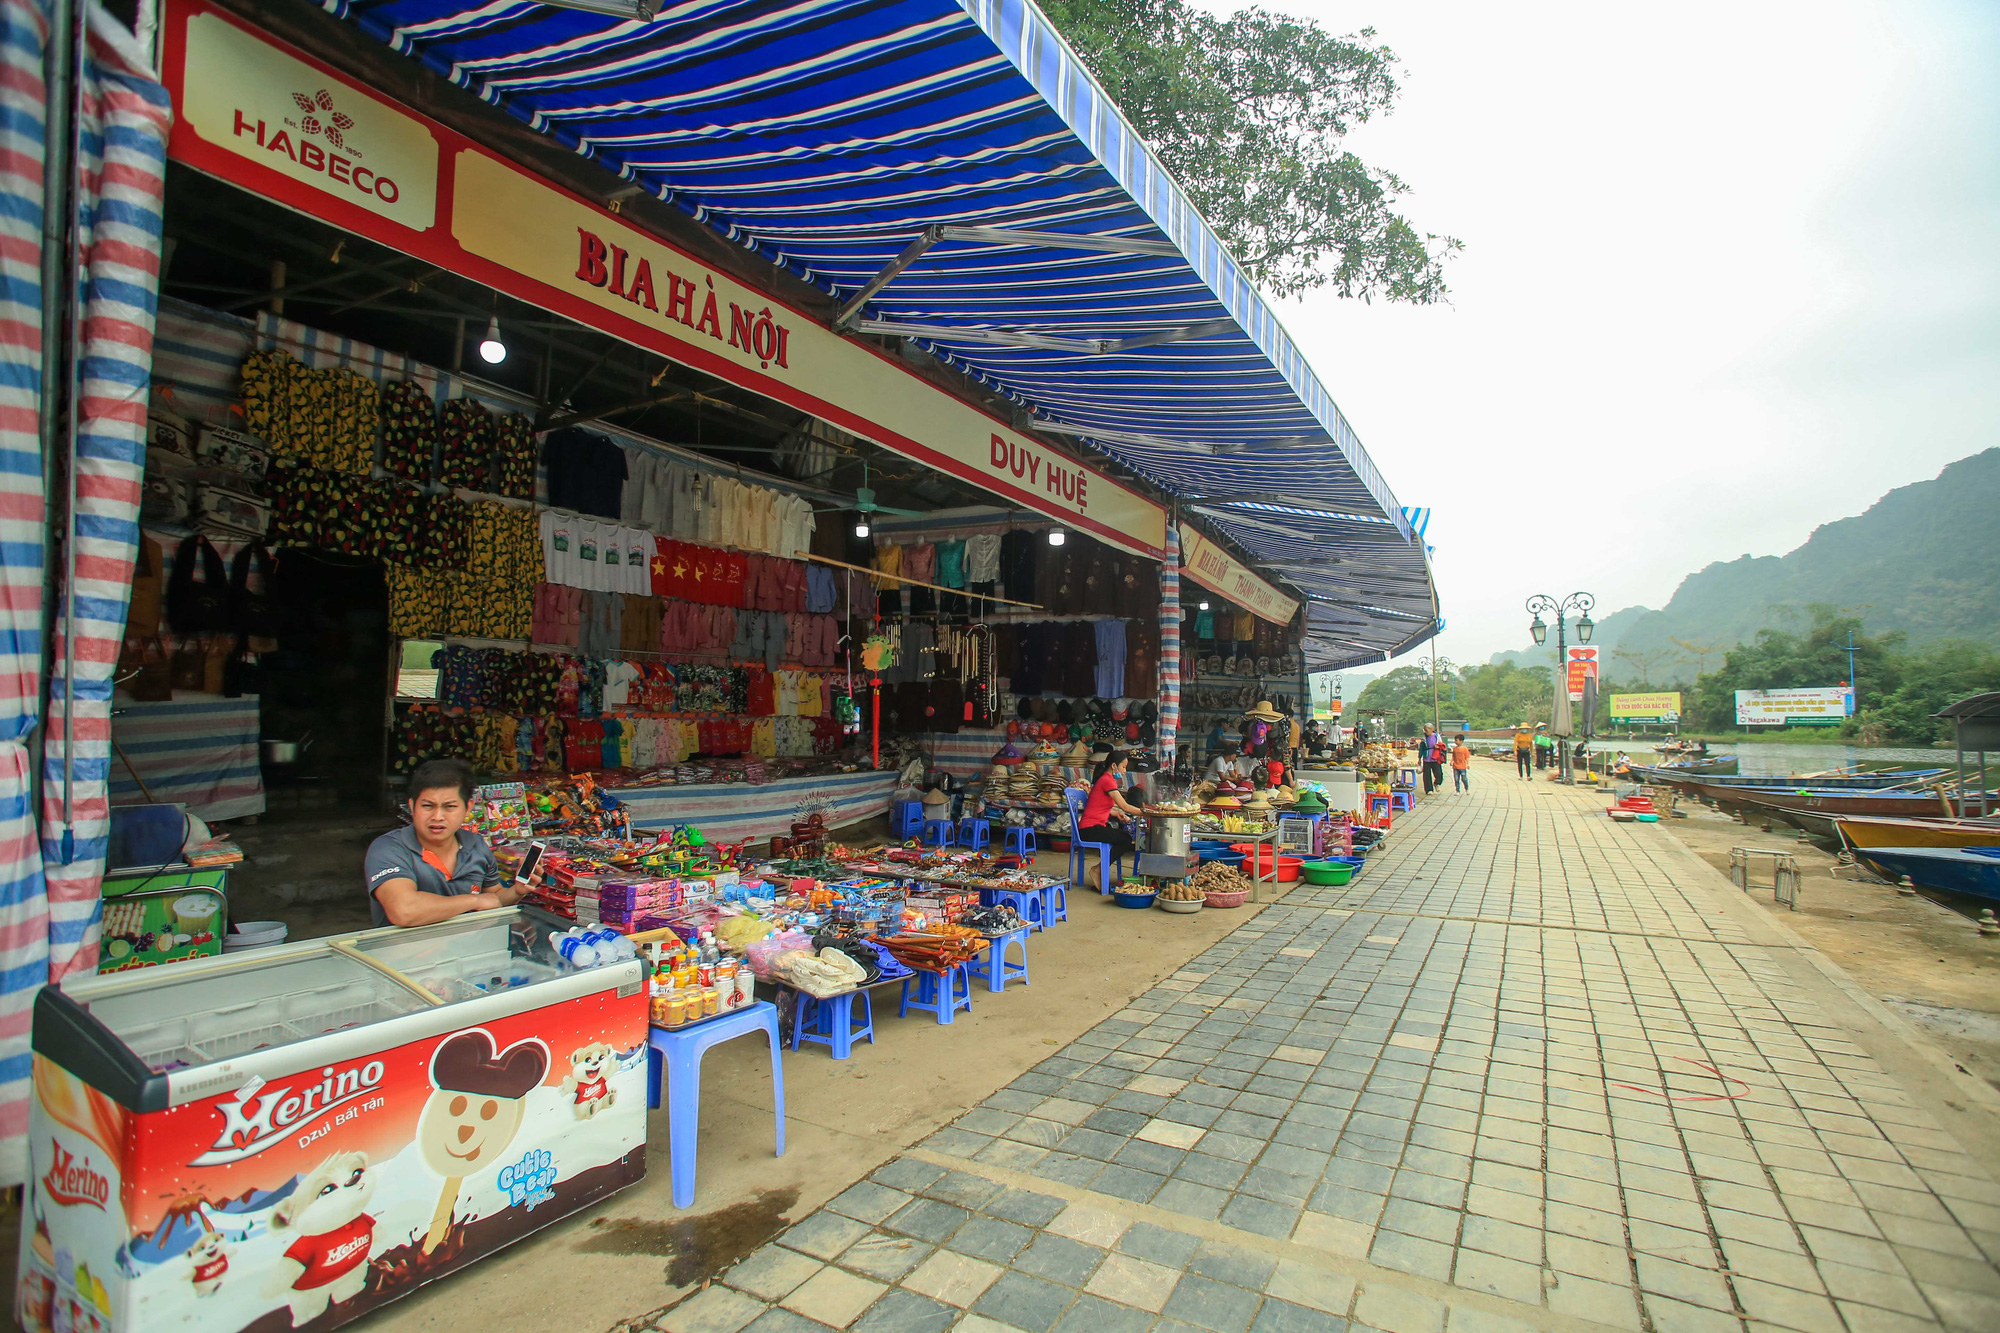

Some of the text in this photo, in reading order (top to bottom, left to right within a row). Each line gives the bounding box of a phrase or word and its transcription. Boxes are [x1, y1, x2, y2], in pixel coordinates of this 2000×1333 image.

[284, 117, 298, 129] Est.
[234, 108, 399, 204] HABECO
[345, 146, 363, 158] 1890
[575, 226, 790, 370] BIA HÀ NỘI
[990, 432, 1088, 514] DUY HUỆ
[371, 866, 400, 882] ENEOS
[211, 1060, 385, 1148] Merino
[298, 1122, 331, 1149] Dzui
[335, 1105, 358, 1126] Bất
[43, 1136, 109, 1209] Merino
[500, 1150, 551, 1190] Cutie
[511, 1167, 557, 1204] Bear
[326, 1234, 369, 1262] Merino
